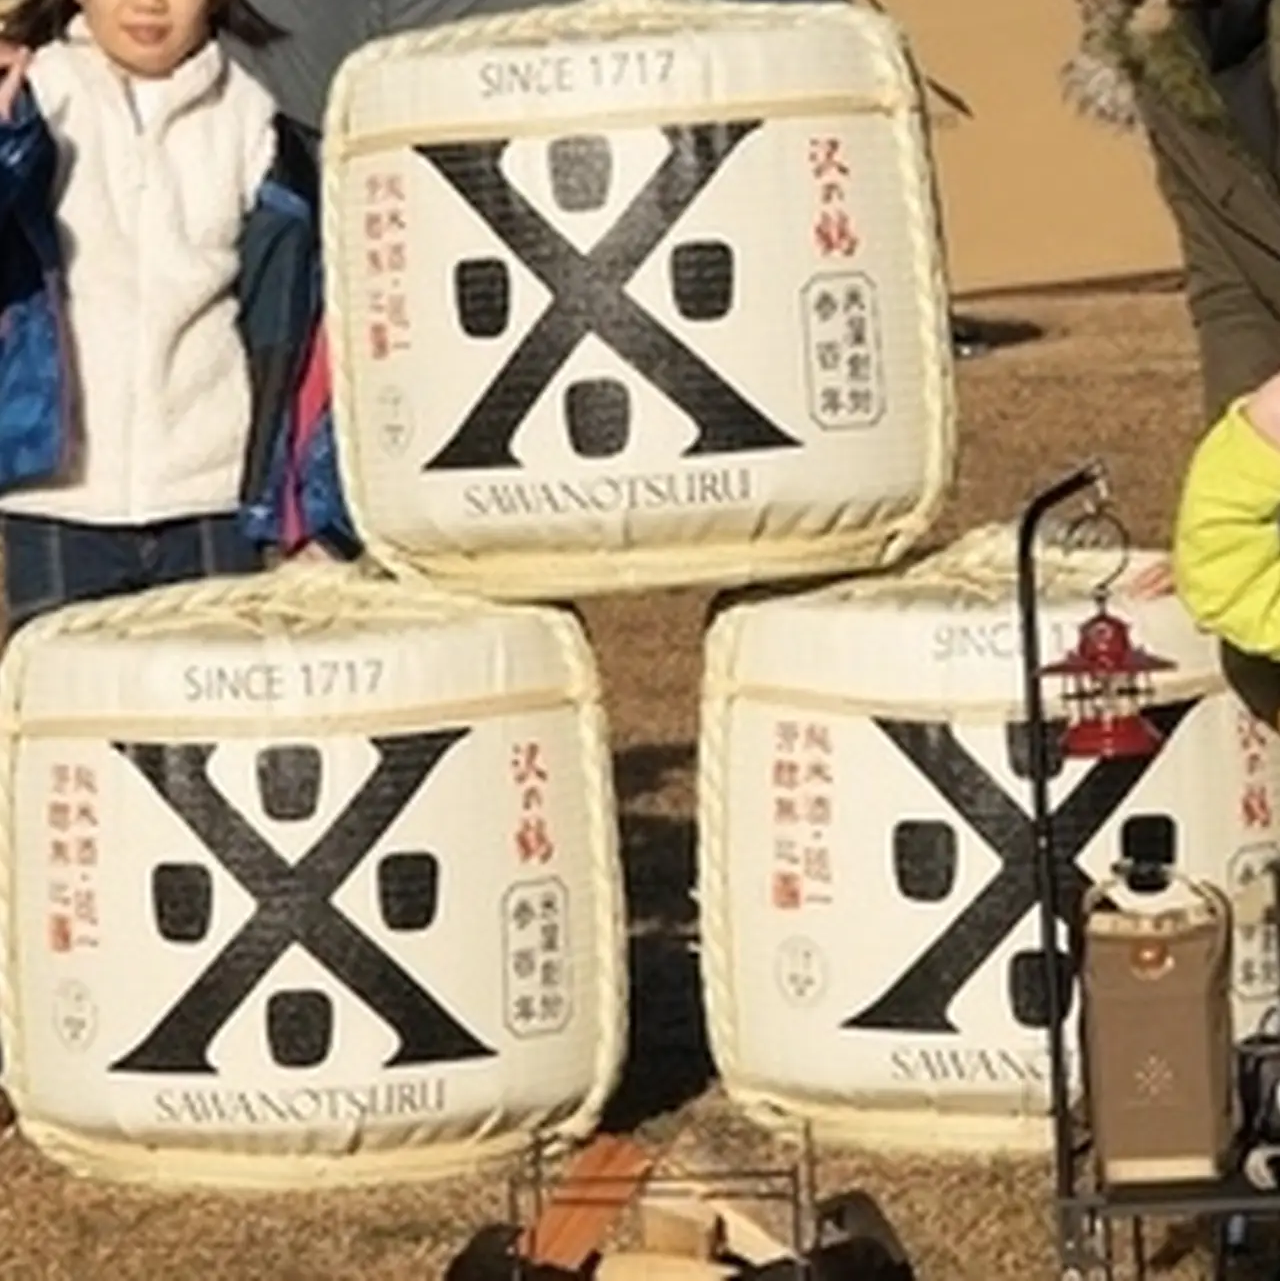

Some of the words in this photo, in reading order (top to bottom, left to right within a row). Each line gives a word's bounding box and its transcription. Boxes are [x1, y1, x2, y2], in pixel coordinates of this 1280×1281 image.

[479, 56, 574, 100] SINCE
[589, 48, 675, 87] 1717
[809, 136, 858, 258] 沢の鶴
[463, 468, 751, 518] SAWANOTSURU
[933, 622, 1022, 660] SINC
[184, 664, 284, 701] SINCE
[300, 658, 383, 696] 1717
[511, 743, 554, 865] 沢の鶴
[155, 1078, 445, 1123] SAWANOTSURU
